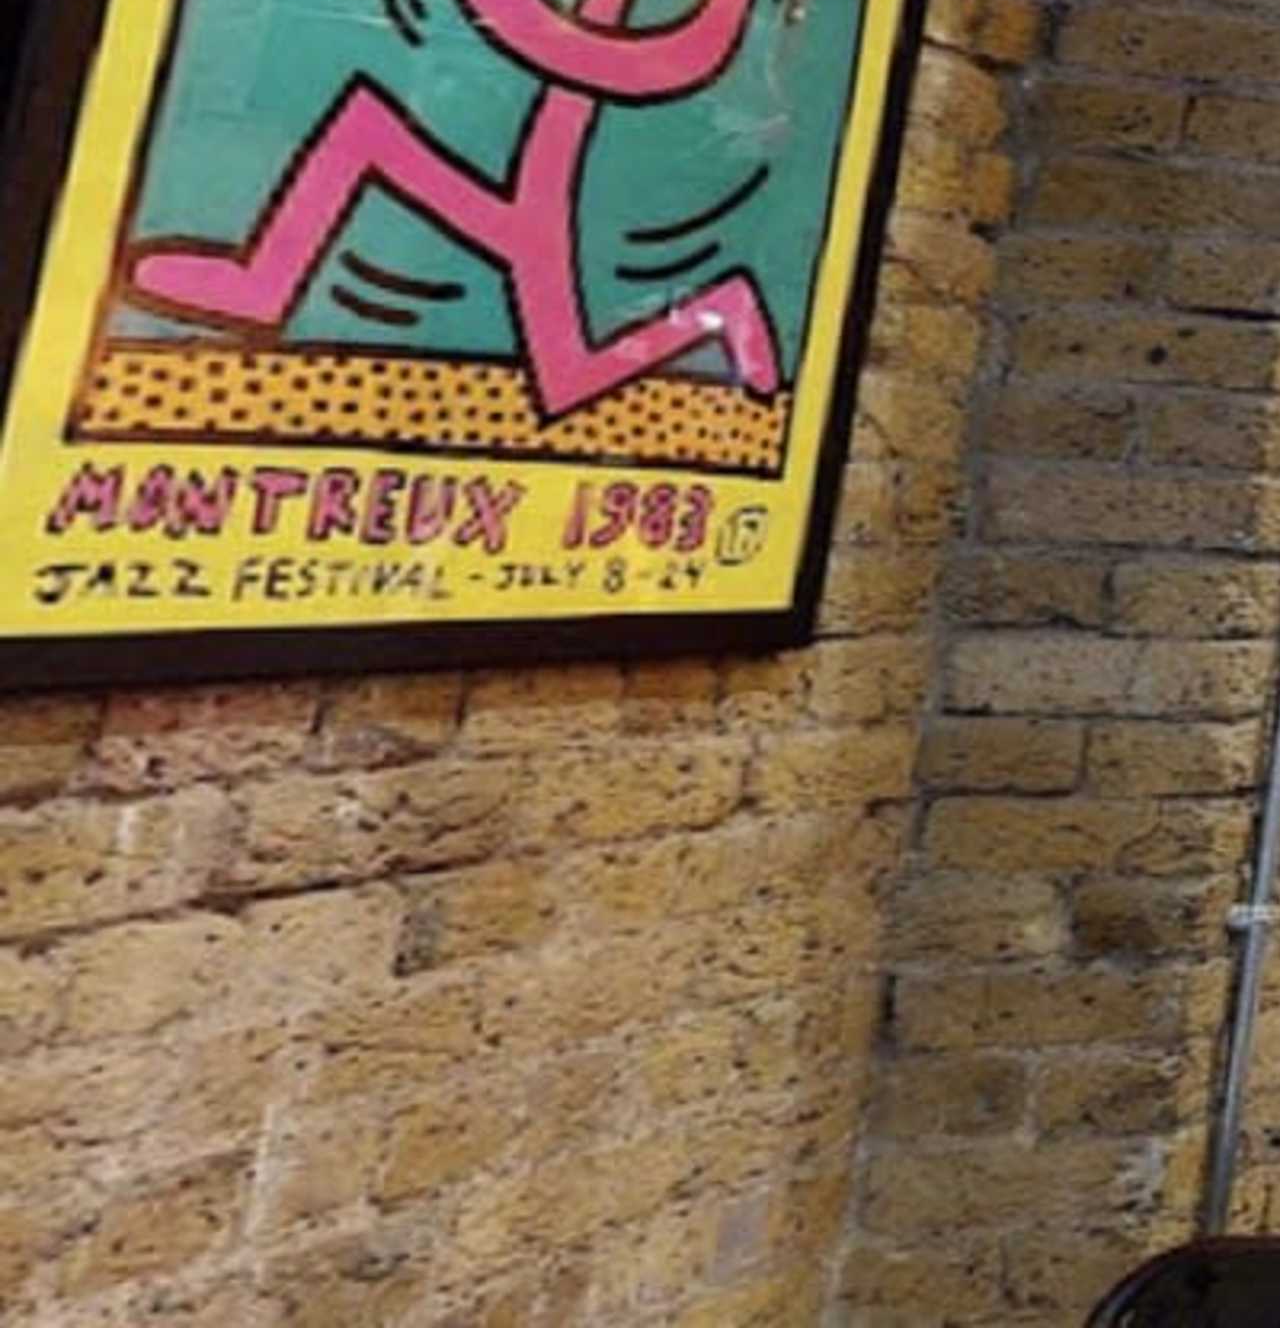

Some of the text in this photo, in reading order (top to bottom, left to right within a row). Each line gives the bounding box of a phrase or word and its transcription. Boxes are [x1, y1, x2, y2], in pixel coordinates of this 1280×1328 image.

[44, 462, 528, 556] MONTREUX
[562, 481, 714, 553] 1983
[33, 559, 212, 604] JAZZ
[231, 557, 453, 602] FESTIVAL
[494, 561, 586, 590] JULY
